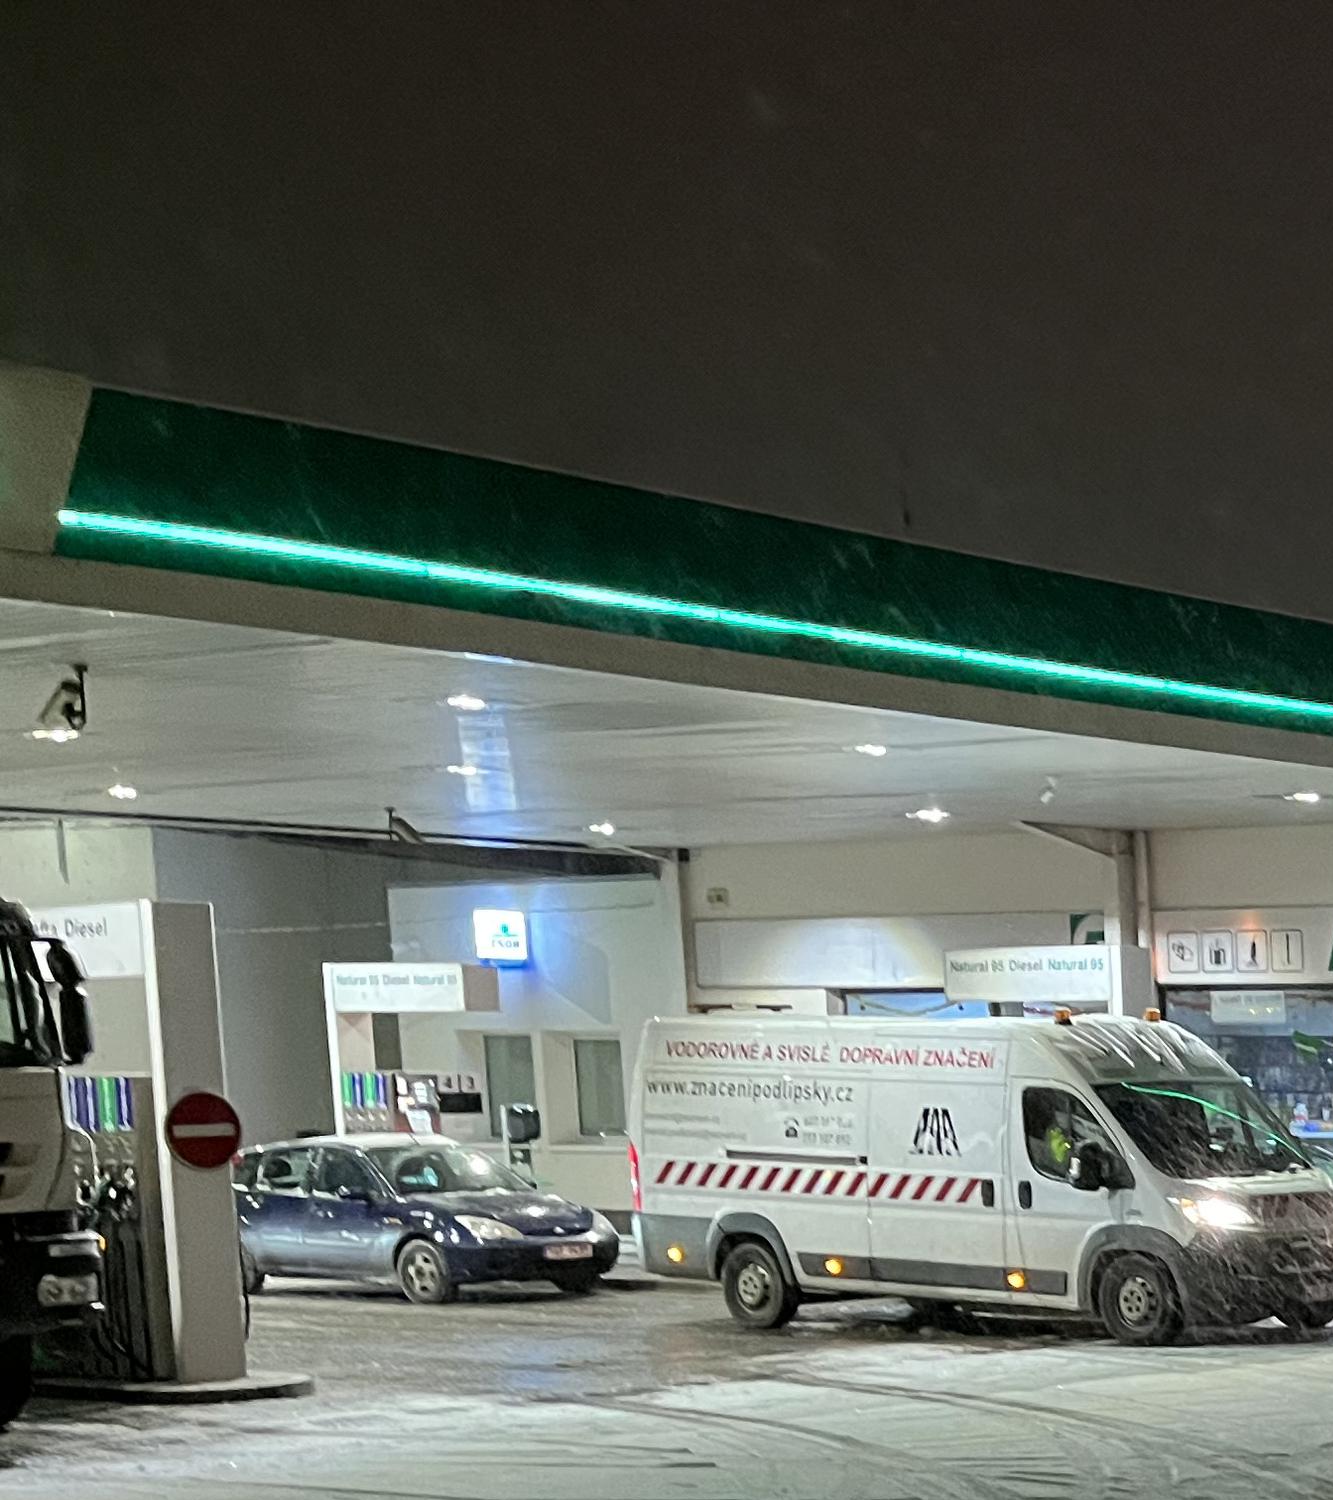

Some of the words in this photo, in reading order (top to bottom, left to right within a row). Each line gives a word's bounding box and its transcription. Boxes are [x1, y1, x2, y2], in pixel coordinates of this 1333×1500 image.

[64, 917, 107, 937] Diesel
[950, 959, 988, 972] Natural
[1009, 958, 1042, 971] Diesel
[1048, 958, 1087, 970] Natural
[1091, 958, 1103, 970] 95
[666, 1039, 759, 1061] VODOROVNÉ
[762, 1044, 773, 1062] A
[777, 1042, 830, 1063] SVISLÉ
[840, 1044, 919, 1066] DOPRAVNÍ
